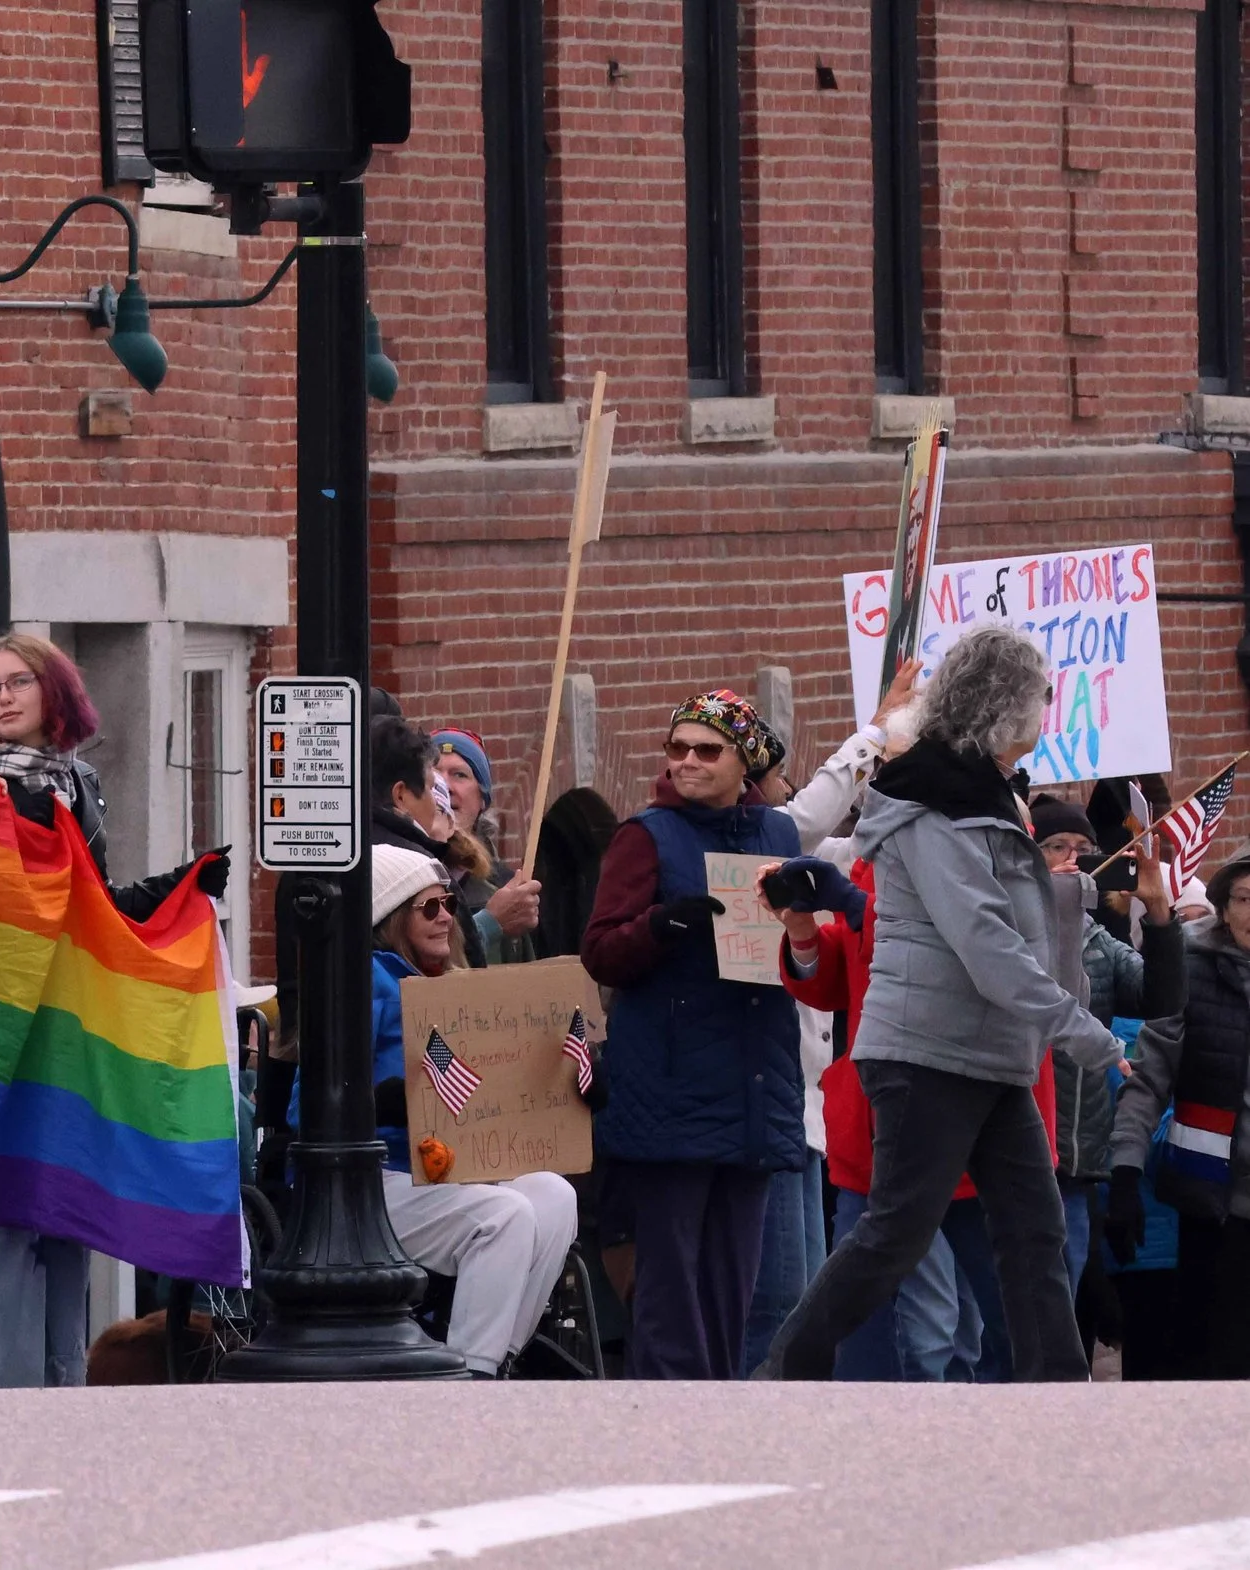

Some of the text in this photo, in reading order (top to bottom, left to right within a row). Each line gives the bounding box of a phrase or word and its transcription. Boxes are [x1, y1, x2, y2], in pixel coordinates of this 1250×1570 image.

[851, 547, 1151, 638] GME of THRONES
[292, 688, 344, 698] START CROSSING
[1039, 667, 1115, 735] HAT
[298, 726, 338, 735] DON'T START
[296, 737, 340, 748] Finish Crossing
[311, 747, 332, 757] Started
[293, 762, 344, 772] TIME REMAINING
[292, 773, 345, 784] To Finish Crossing
[298, 800, 339, 810] DON'T CROSS
[281, 830, 334, 840] PUSH BUTTON
[288, 847, 327, 857] TO CROSS
[710, 857, 748, 889] NO
[716, 931, 766, 961] THE
[441, 1003, 470, 1036] Left
[550, 1001, 574, 1027] Bein
